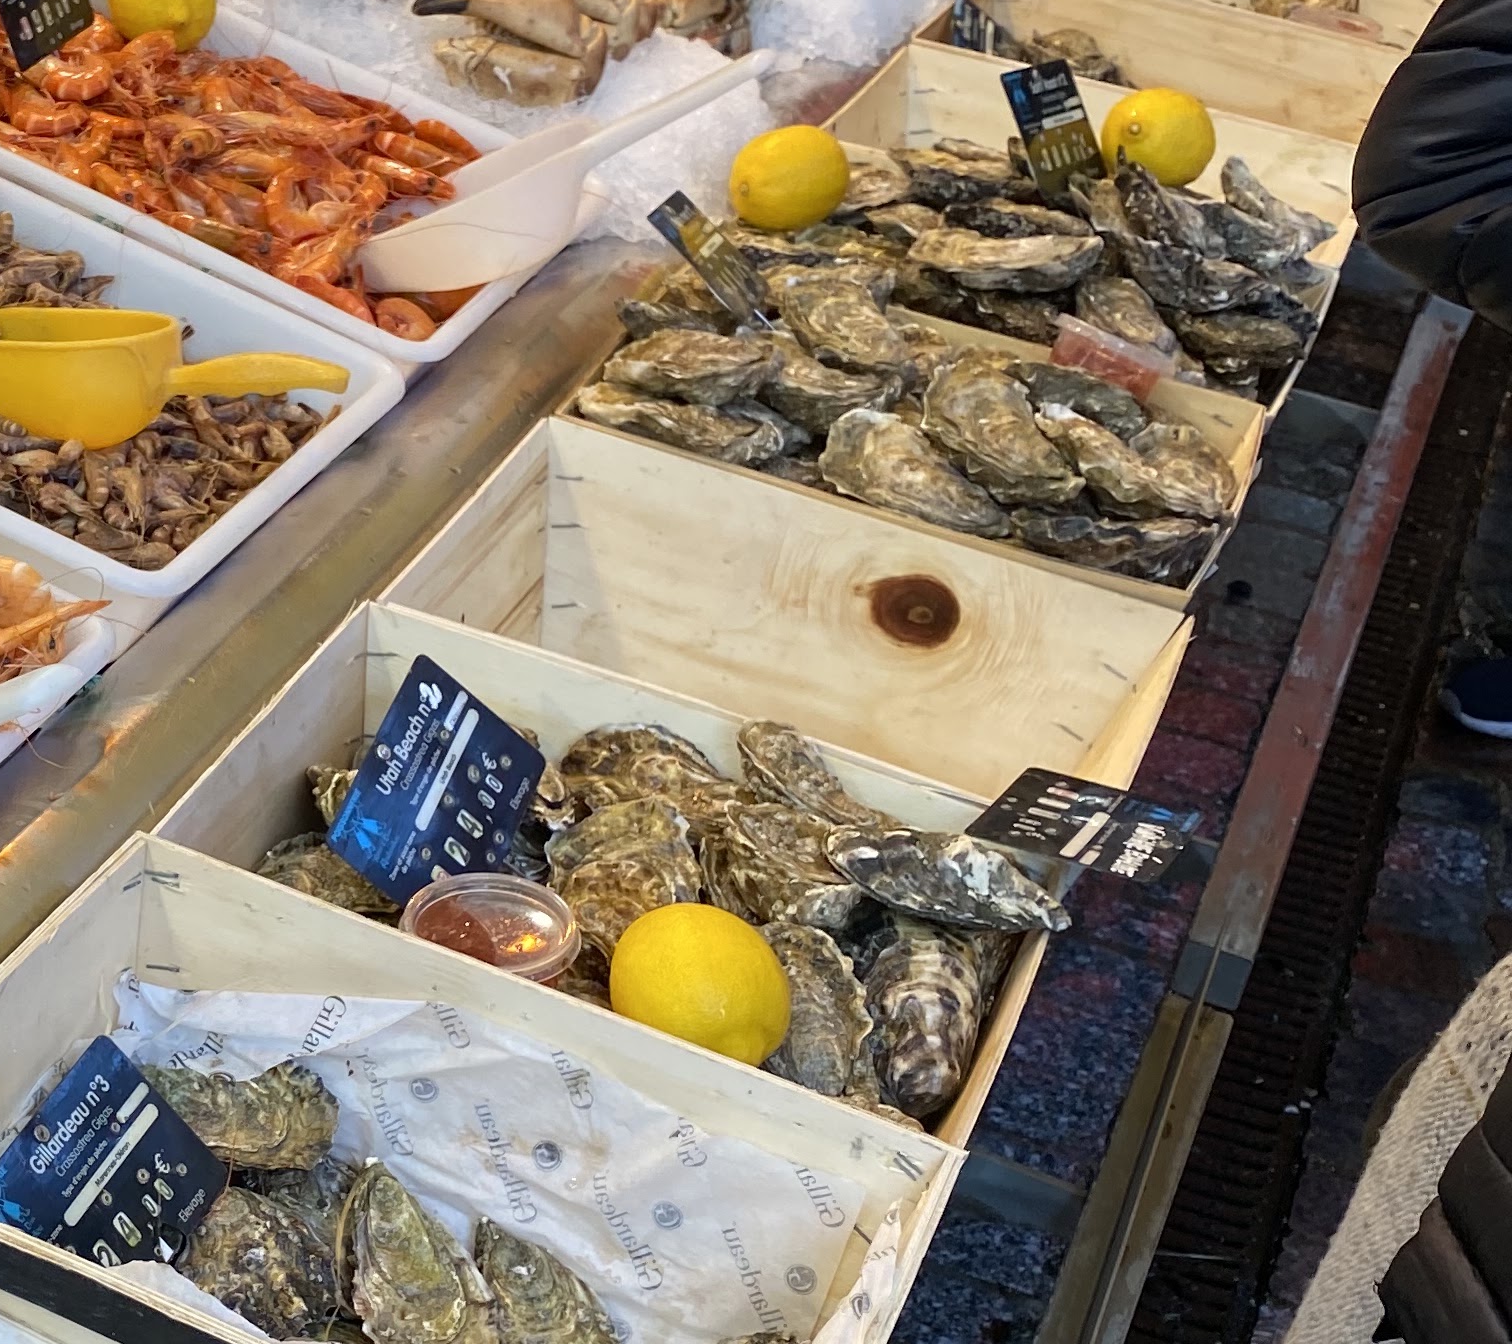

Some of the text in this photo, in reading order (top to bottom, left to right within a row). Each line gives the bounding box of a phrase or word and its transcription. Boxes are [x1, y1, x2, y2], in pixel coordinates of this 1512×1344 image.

[389, 713, 427, 760] Beach
[373, 757, 406, 796] Utah
[26, 1073, 111, 1176] Gillardeau n°3
[53, 1103, 116, 1177] Crassostrea Gigas
[177, 1187, 208, 1223] Elevage
